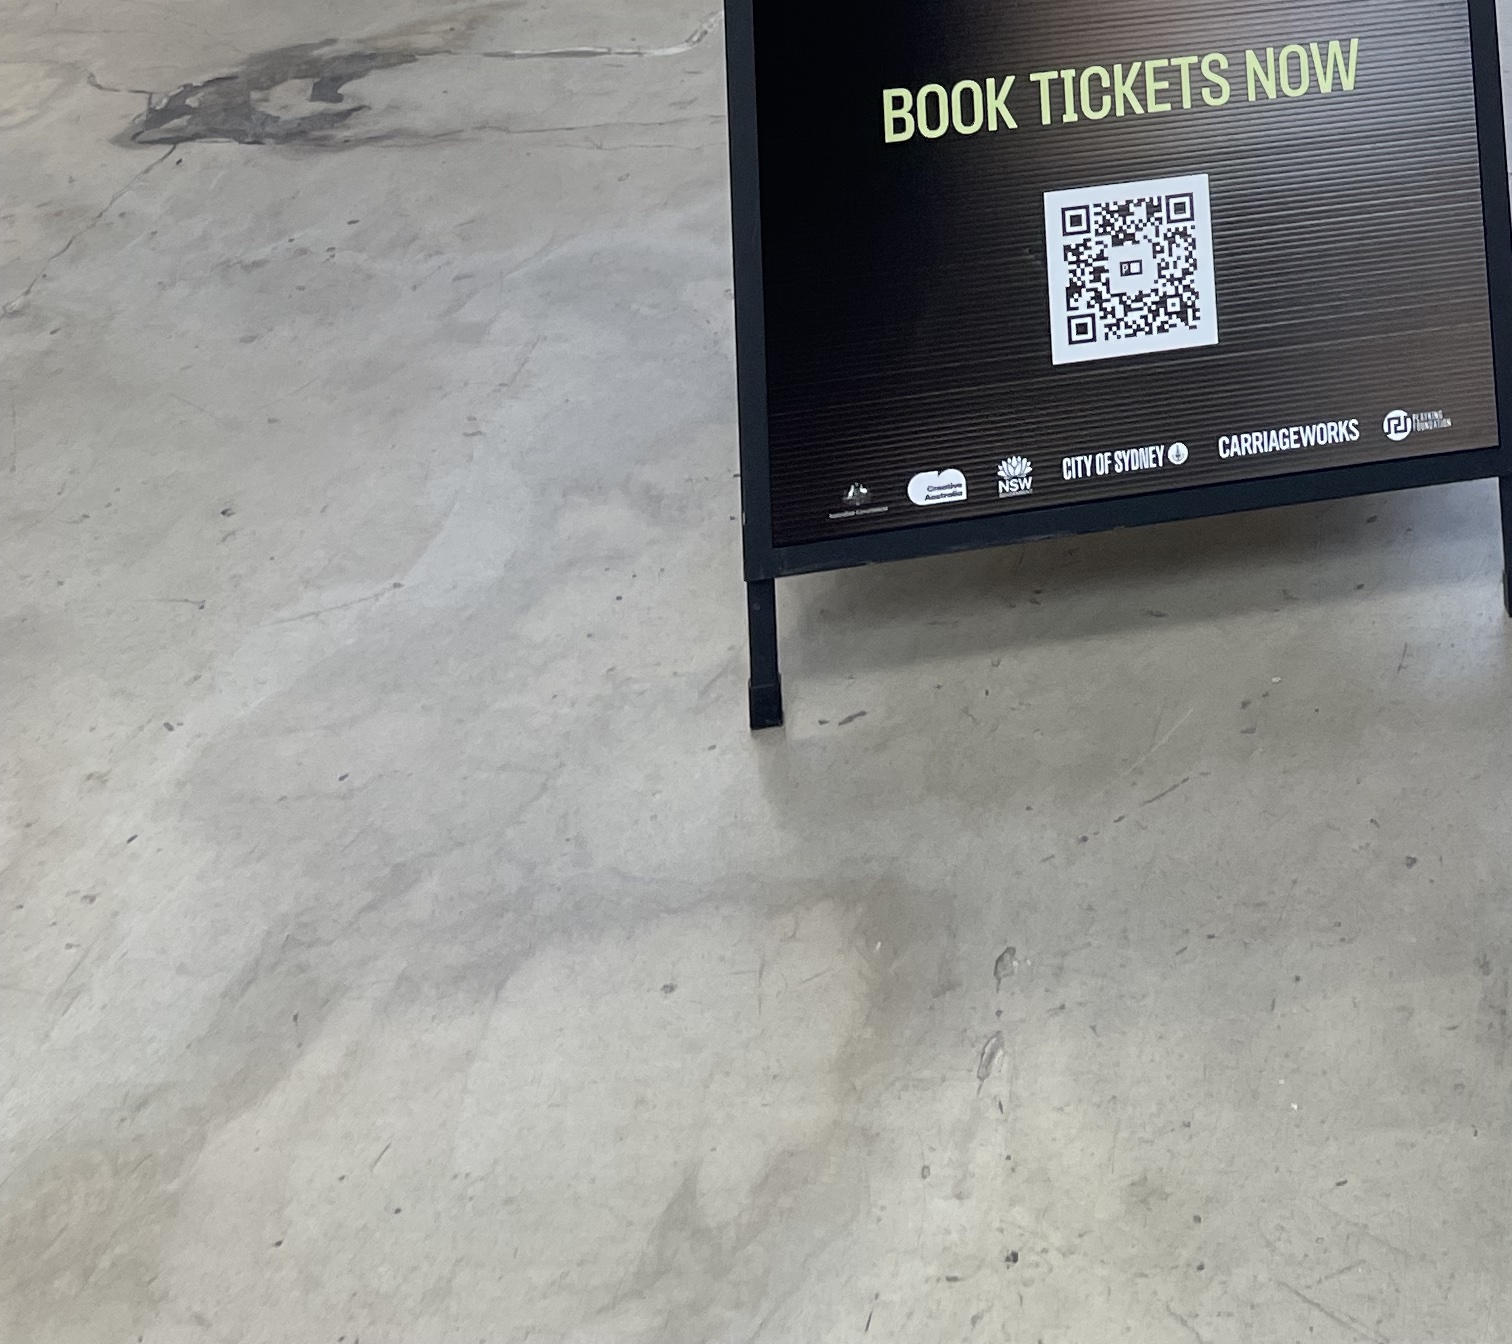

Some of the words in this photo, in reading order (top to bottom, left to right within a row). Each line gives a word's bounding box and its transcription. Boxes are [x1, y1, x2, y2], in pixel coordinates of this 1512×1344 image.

[882, 75, 1018, 144] BOOK
[1030, 52, 1232, 126] TICKETS
[1244, 38, 1360, 102] NOW
[1218, 419, 1360, 459] CARRIAGEWORKS
[1062, 454, 1093, 480] CITY
[1095, 451, 1112, 475] OF
[1114, 444, 1165, 473] SYDNEY
[998, 476, 1033, 492] NSW
